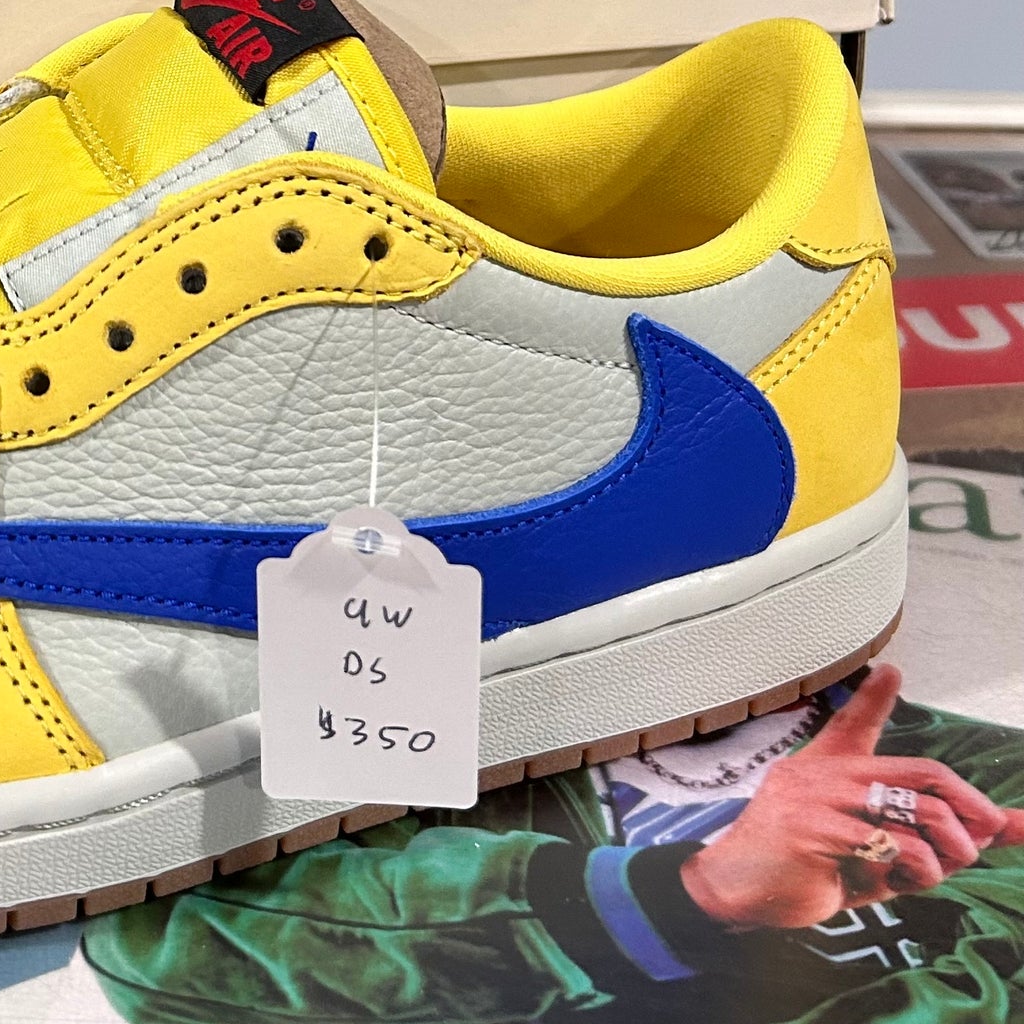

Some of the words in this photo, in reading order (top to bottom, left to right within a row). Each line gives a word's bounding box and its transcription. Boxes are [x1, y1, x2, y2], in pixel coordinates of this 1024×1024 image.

[205, 13, 273, 79] AIR
[343, 650, 387, 684] DS
[318, 706, 436, 752] $350
